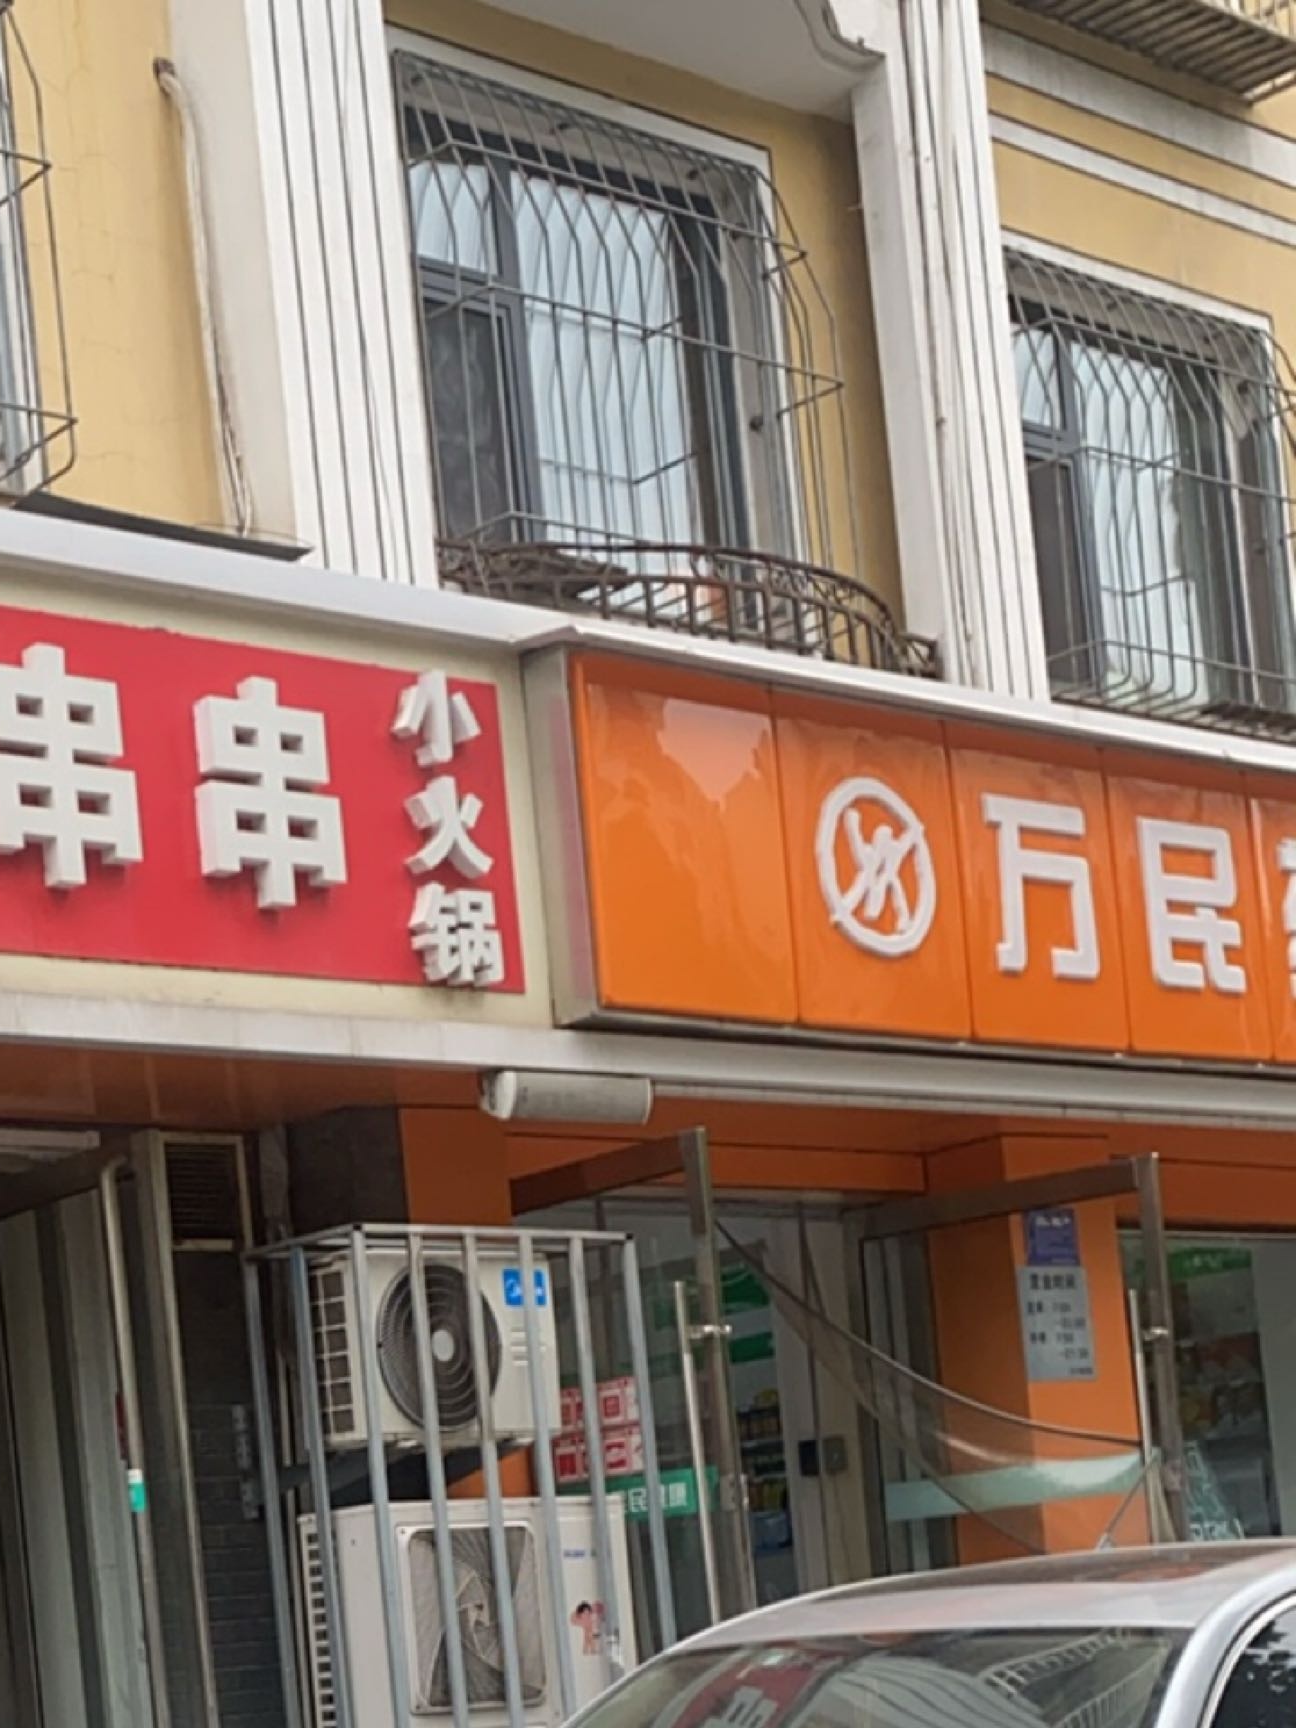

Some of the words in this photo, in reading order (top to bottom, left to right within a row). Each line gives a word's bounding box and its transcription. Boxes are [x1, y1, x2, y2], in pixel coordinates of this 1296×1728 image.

[390, 669, 504, 987] 小火锅
[980, 792, 1296, 1000] 万民
